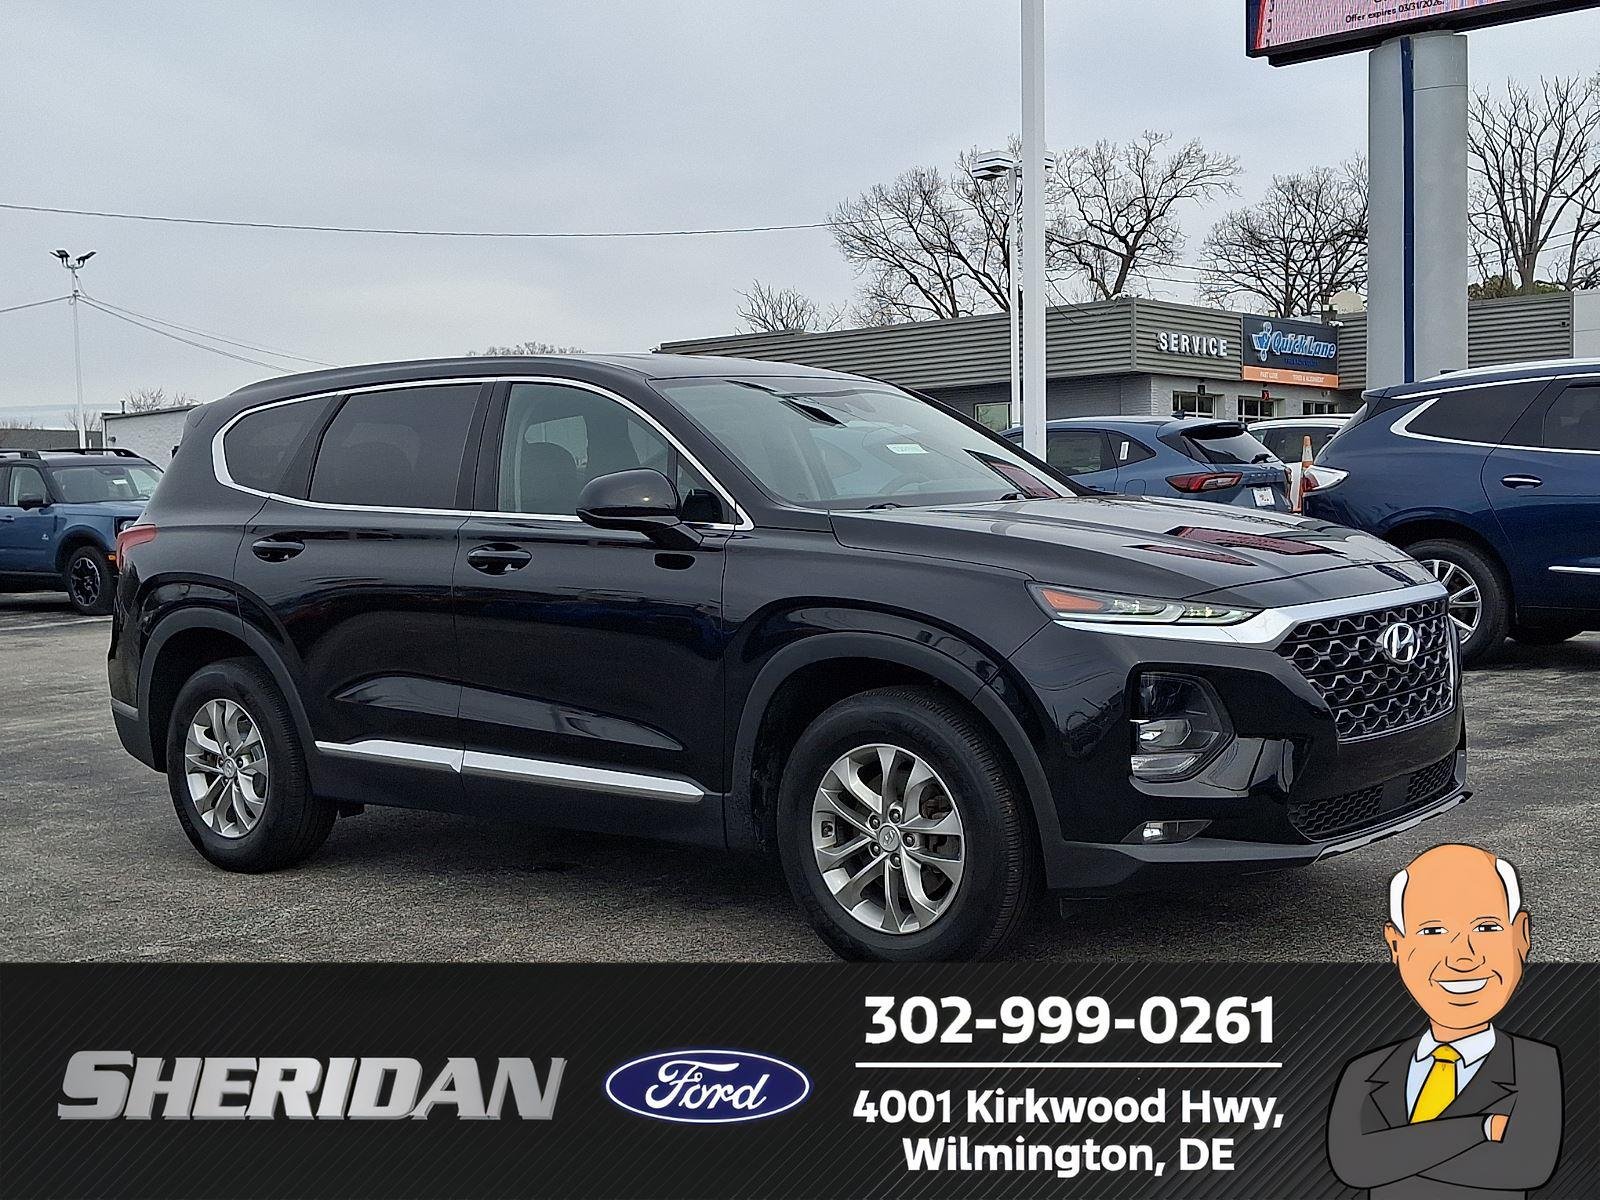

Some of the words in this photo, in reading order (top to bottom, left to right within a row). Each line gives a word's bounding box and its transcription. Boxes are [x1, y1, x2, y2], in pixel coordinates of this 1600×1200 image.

[1345, 14, 1366, 23] Offer
[1368, 8, 1397, 19] expires
[1157, 331, 1228, 357] SERVICE
